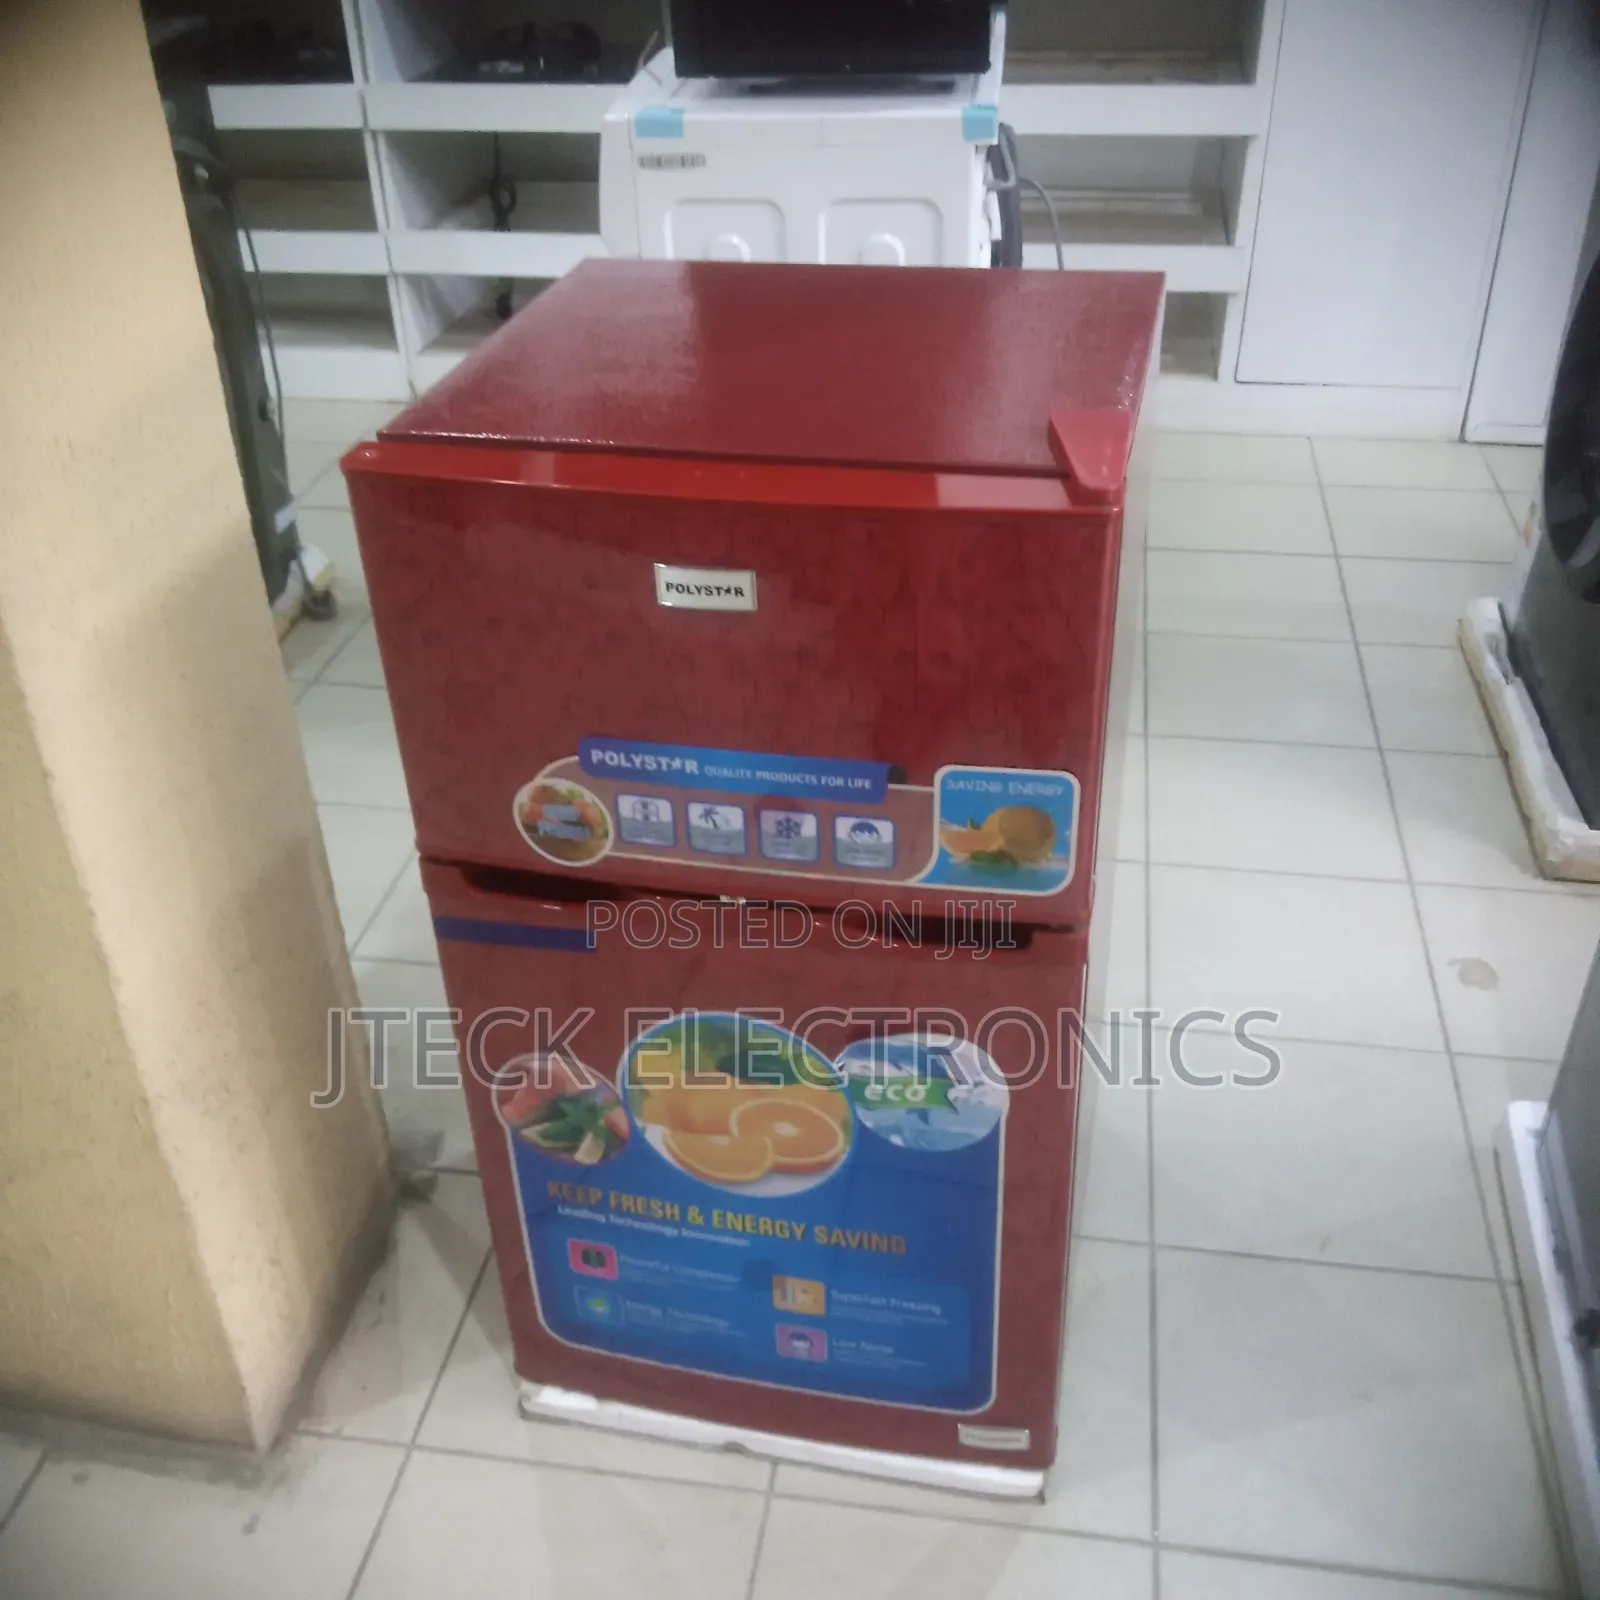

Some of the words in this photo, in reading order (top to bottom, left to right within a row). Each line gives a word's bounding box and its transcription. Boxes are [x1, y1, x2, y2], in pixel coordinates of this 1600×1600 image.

[704, 766, 752, 780] QUALITY
[756, 770, 818, 786] PRODUCTS
[821, 775, 845, 788] FOR
[848, 777, 872, 790] LIFE
[946, 778, 1003, 794] SAVING
[1008, 781, 1065, 796] ENERGY
[547, 1181, 602, 1205] KEEP
[609, 1191, 681, 1222] FRESH
[687, 1205, 704, 1226] &
[712, 1209, 806, 1240] ENERGY
[814, 1225, 907, 1256] SAVING
